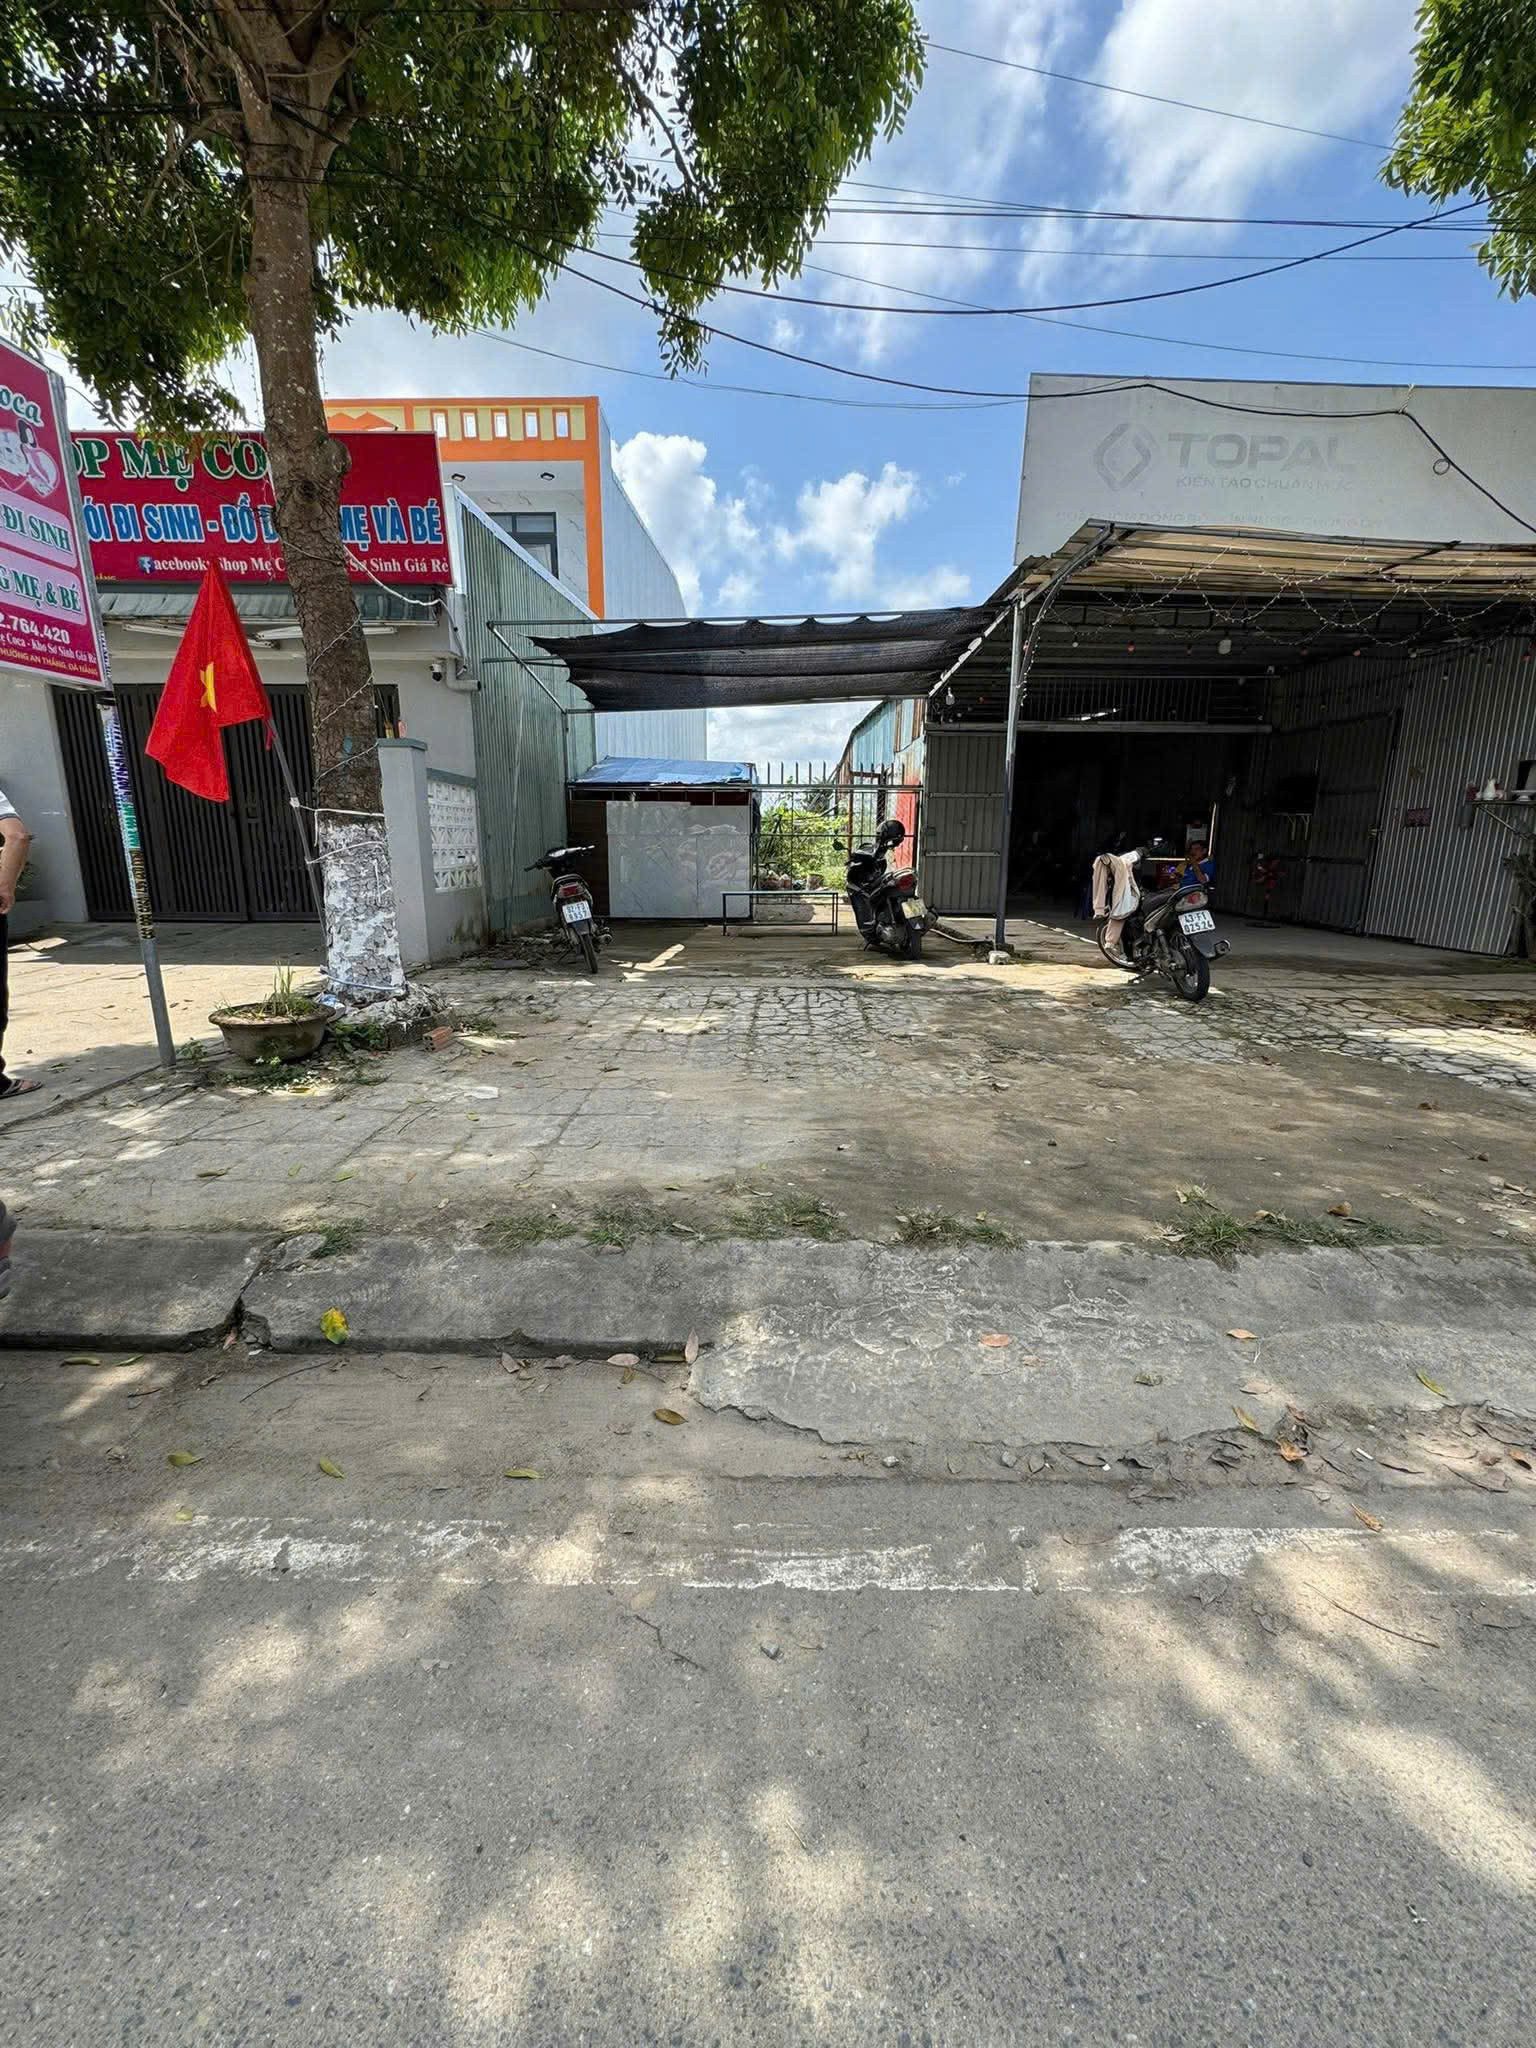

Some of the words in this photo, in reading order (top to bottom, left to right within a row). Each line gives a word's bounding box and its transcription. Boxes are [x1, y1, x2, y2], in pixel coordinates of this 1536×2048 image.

[0, 384, 44, 427] oca
[1168, 432, 1356, 472] TOPAL
[28, 515, 72, 554] SINH
[112, 504, 143, 542] ĐI
[143, 503, 205, 543] SINH
[371, 497, 408, 544] VÀ
[408, 498, 444, 544] BÉ
[370, 557, 401, 573] Sinh
[404, 557, 429, 573] Giá
[12, 569, 42, 609] MẸ
[45, 583, 57, 608] &
[58, 583, 82, 613] BÉ
[0, 612, 70, 644] 2.764.420
